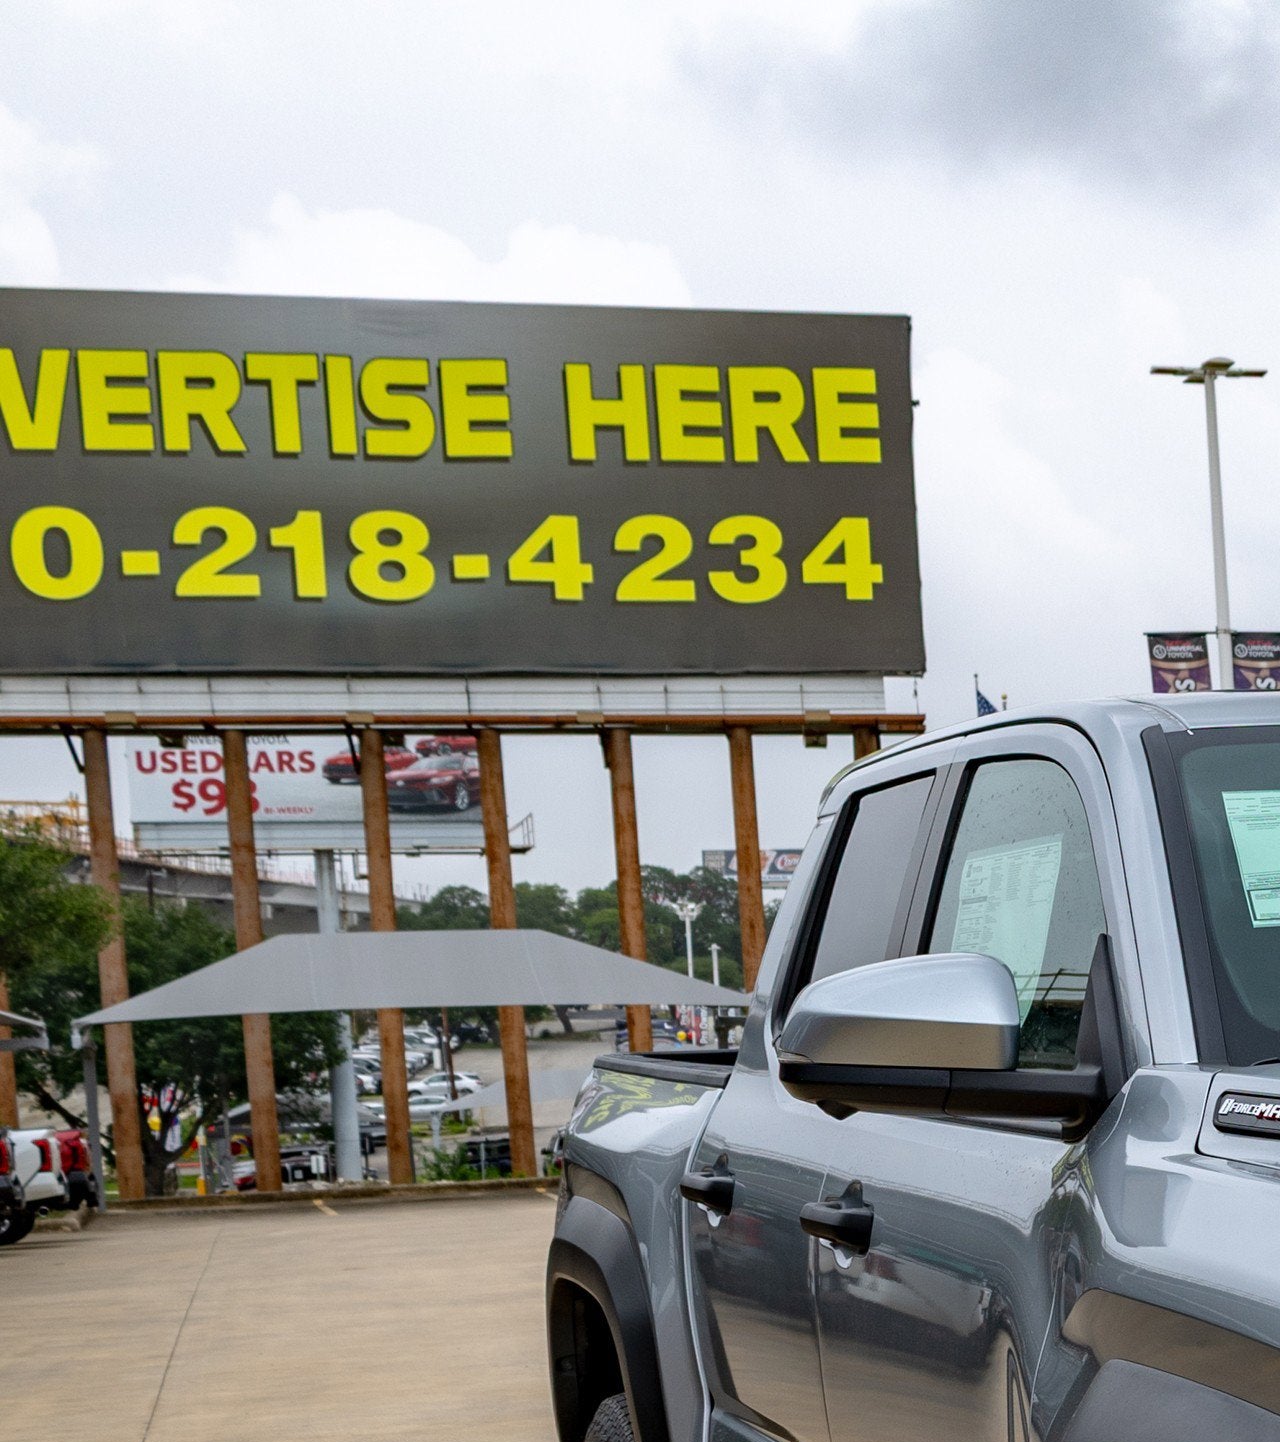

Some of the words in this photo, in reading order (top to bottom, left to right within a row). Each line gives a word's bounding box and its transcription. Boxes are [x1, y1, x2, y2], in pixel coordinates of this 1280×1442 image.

[563, 363, 882, 464] HERE
[10, 505, 884, 604] 0-218-4234
[135, 749, 224, 774] USED
[250, 750, 316, 774] ARS
